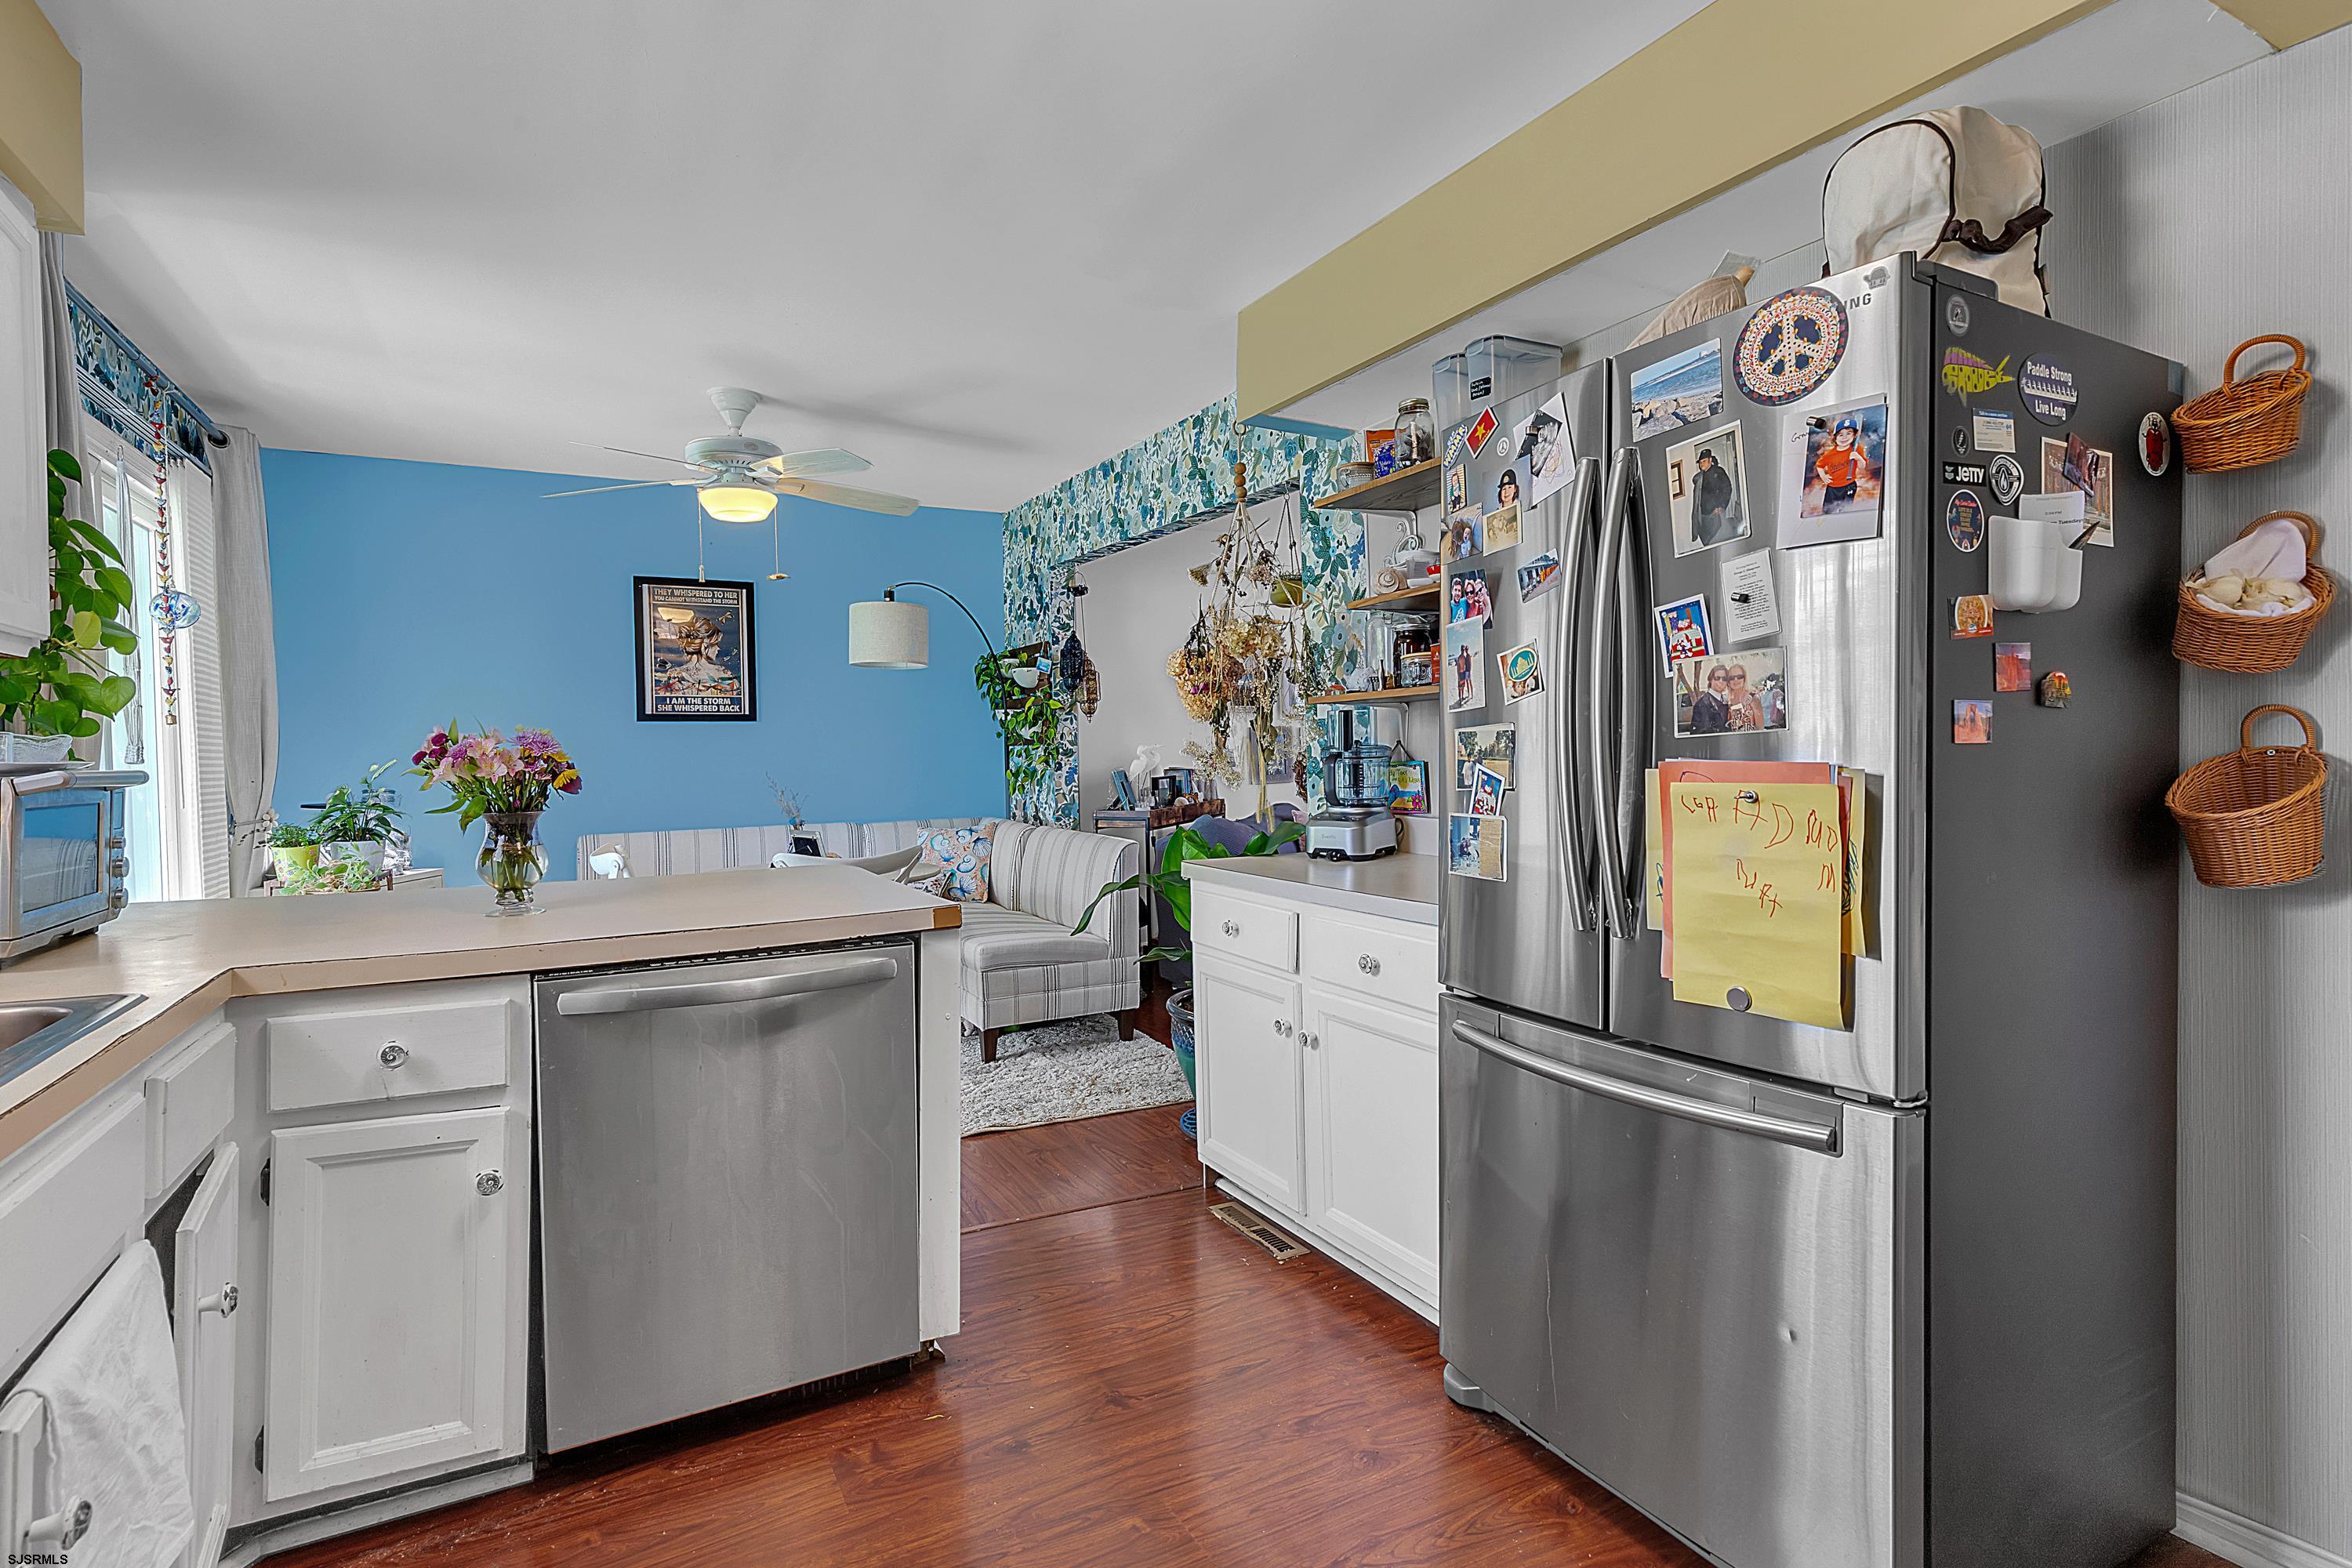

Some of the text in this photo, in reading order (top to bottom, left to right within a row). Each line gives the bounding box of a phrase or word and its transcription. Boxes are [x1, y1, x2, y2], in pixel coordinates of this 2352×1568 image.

[2027, 361, 2072, 386] Paddle Strong
[2035, 400, 2067, 421] Live Long
[673, 589, 713, 597] WHISPERED
